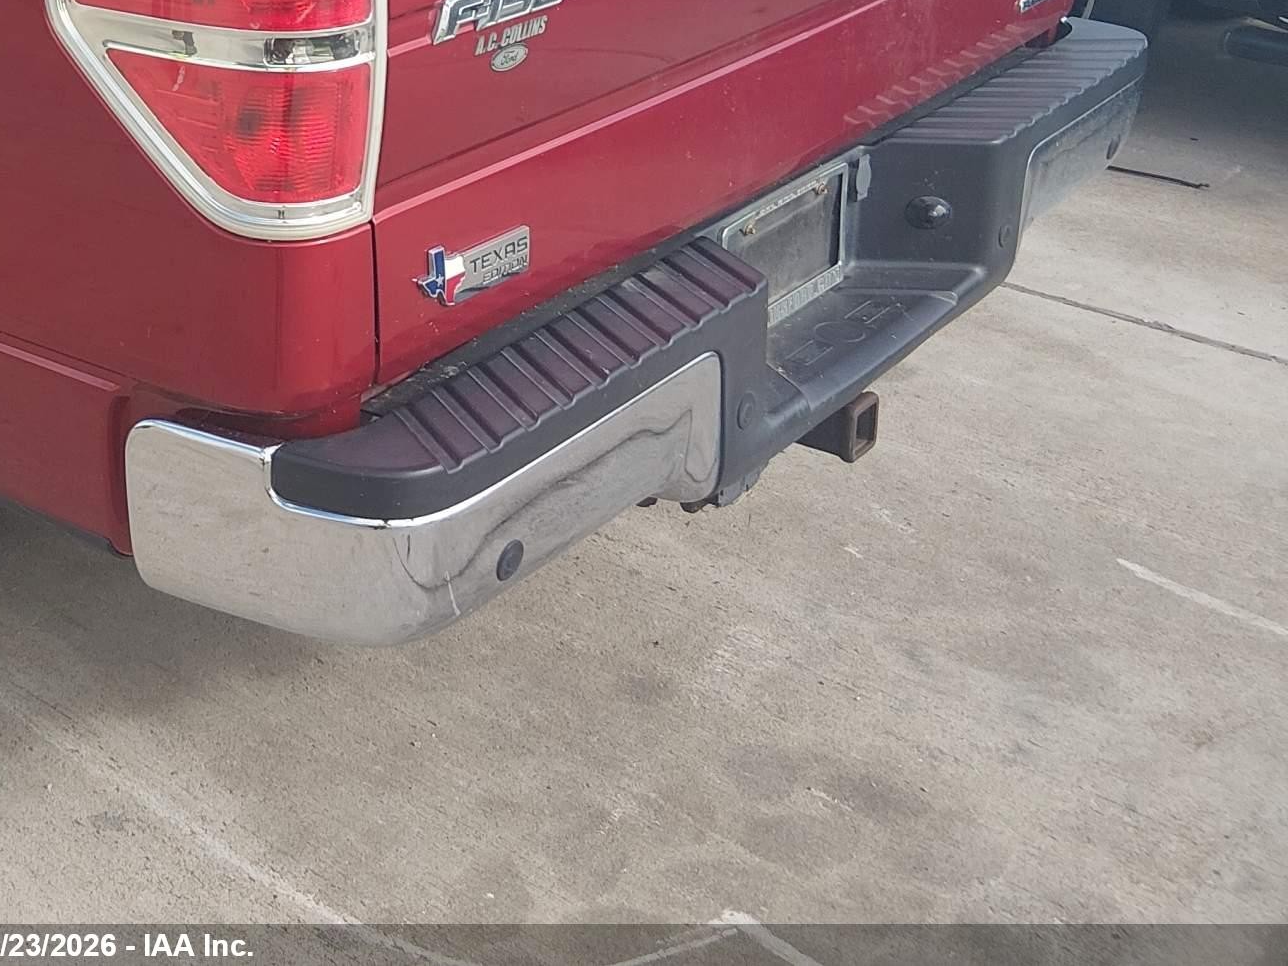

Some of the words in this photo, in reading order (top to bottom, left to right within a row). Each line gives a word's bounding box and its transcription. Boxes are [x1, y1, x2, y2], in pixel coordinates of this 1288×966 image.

[500, 15, 548, 47] COLLINS
[470, 236, 529, 273] TEXAS
[483, 254, 529, 283] EDITION
